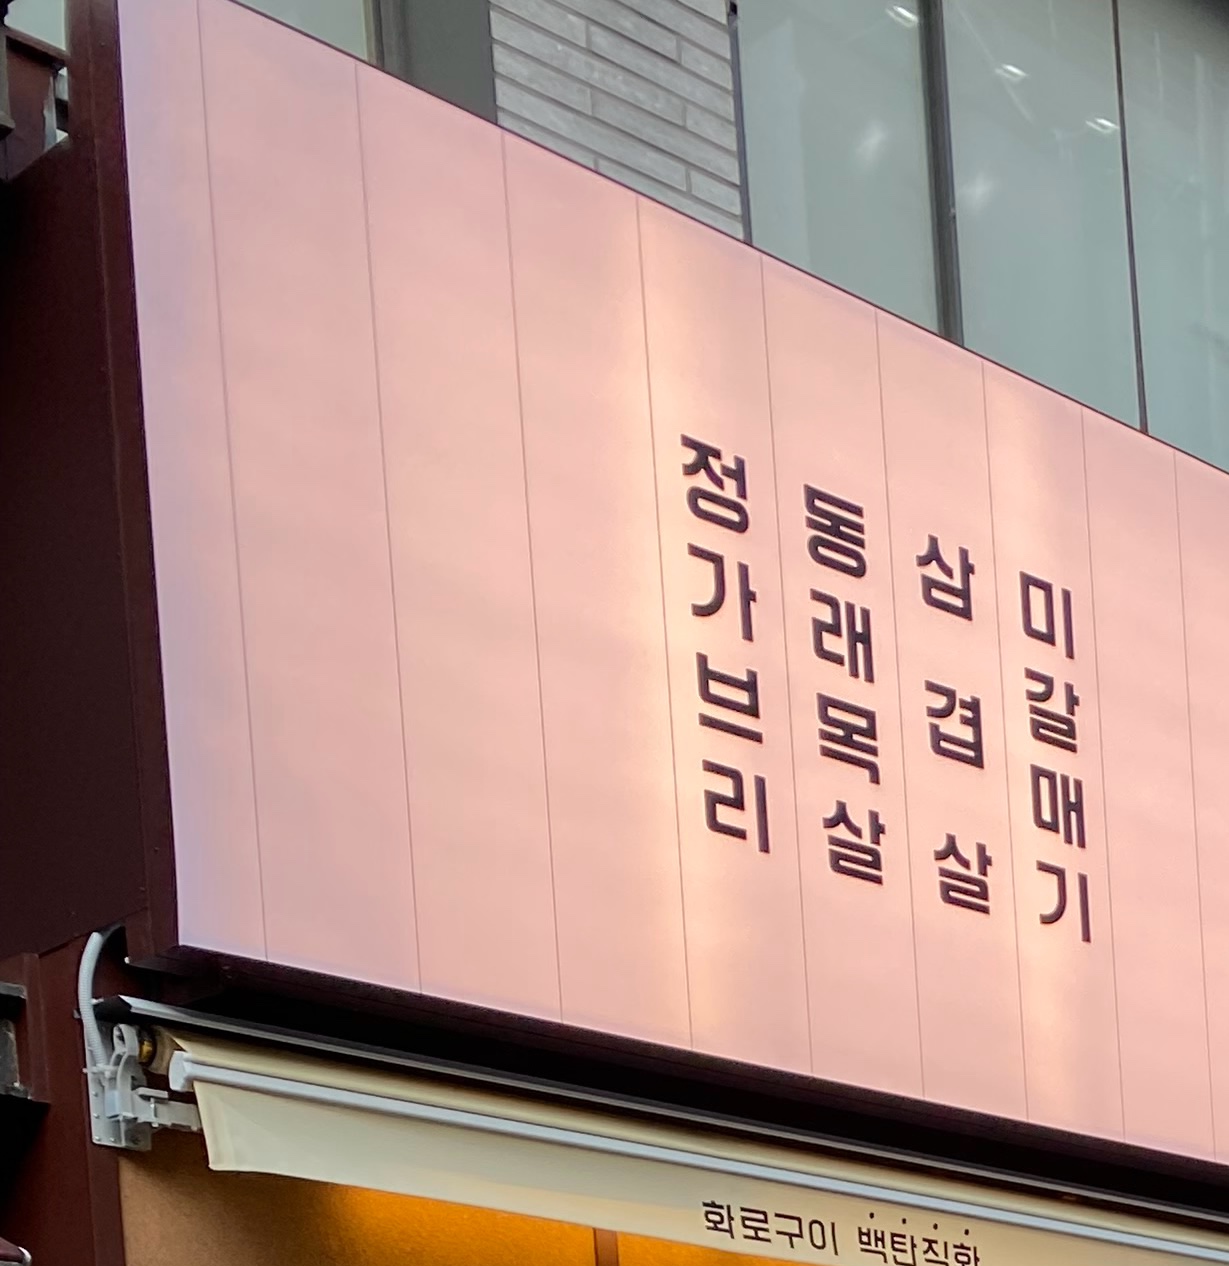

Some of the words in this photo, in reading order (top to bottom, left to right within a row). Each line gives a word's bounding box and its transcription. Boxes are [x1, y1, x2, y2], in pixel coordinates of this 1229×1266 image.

[681, 433, 770, 853] 정가브리
[803, 483, 886, 886] 동래목살
[915, 533, 993, 915] 삼겹살
[1019, 570, 1092, 943] 미갈매기
[702, 1200, 839, 1256] 화로구이
